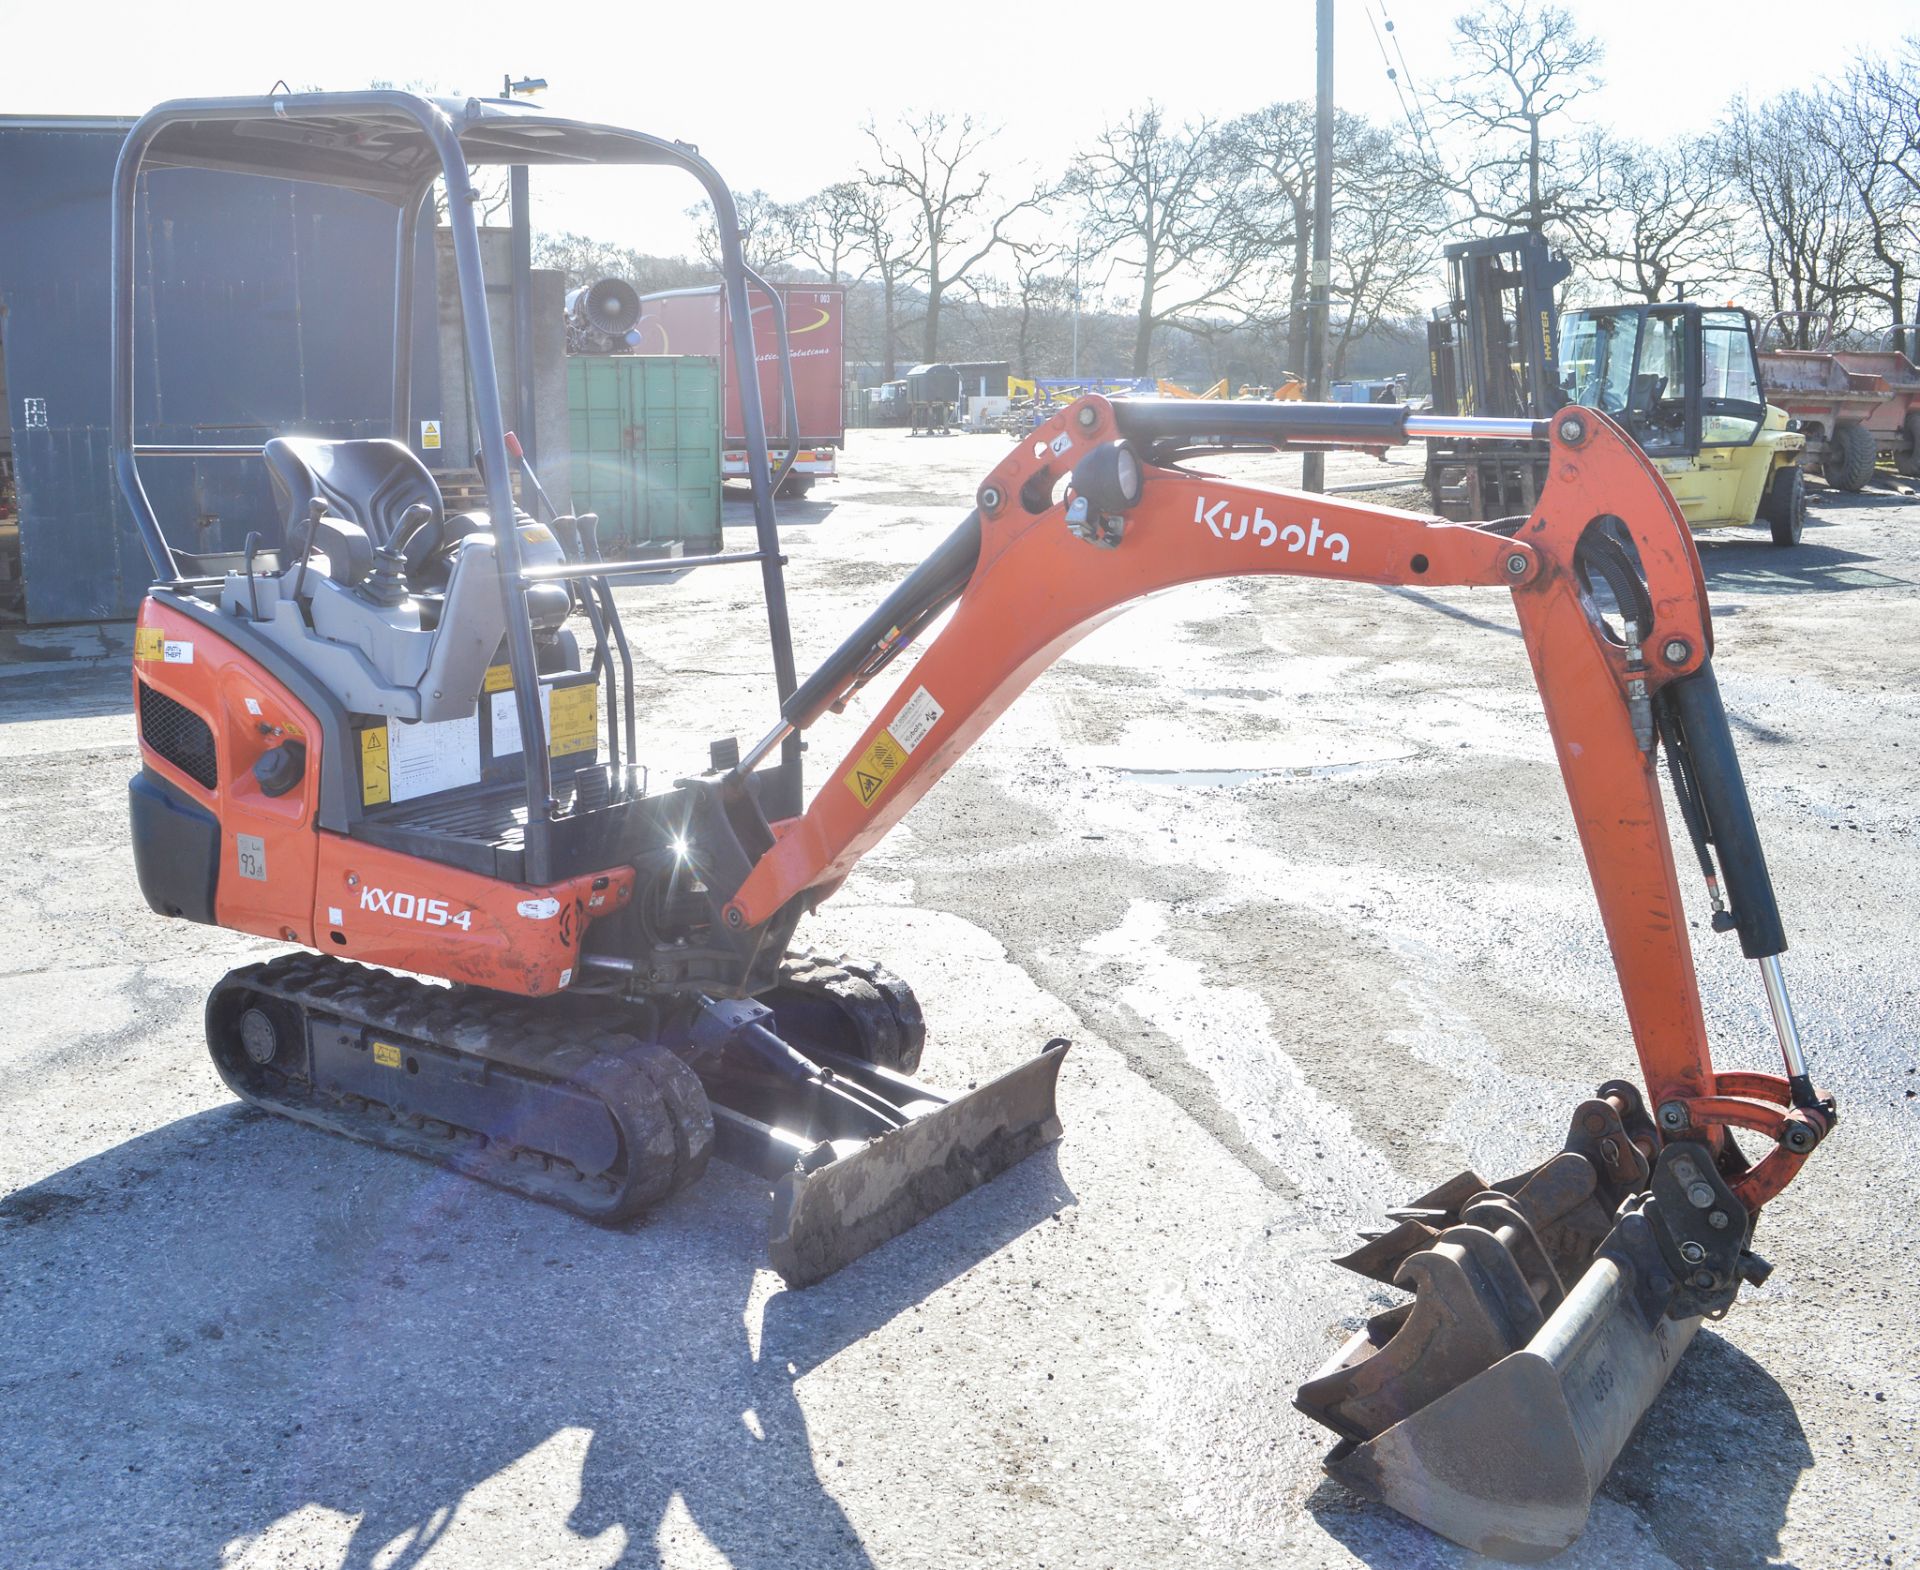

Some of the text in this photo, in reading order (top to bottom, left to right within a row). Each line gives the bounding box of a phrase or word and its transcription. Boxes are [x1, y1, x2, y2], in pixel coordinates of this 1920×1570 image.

[1540, 311, 1552, 361] HYSTER
[1194, 496, 1350, 563] Kubota
[165, 651, 182, 659] THEFT
[240, 853, 256, 876] 93
[360, 885, 472, 932] KX015-4
